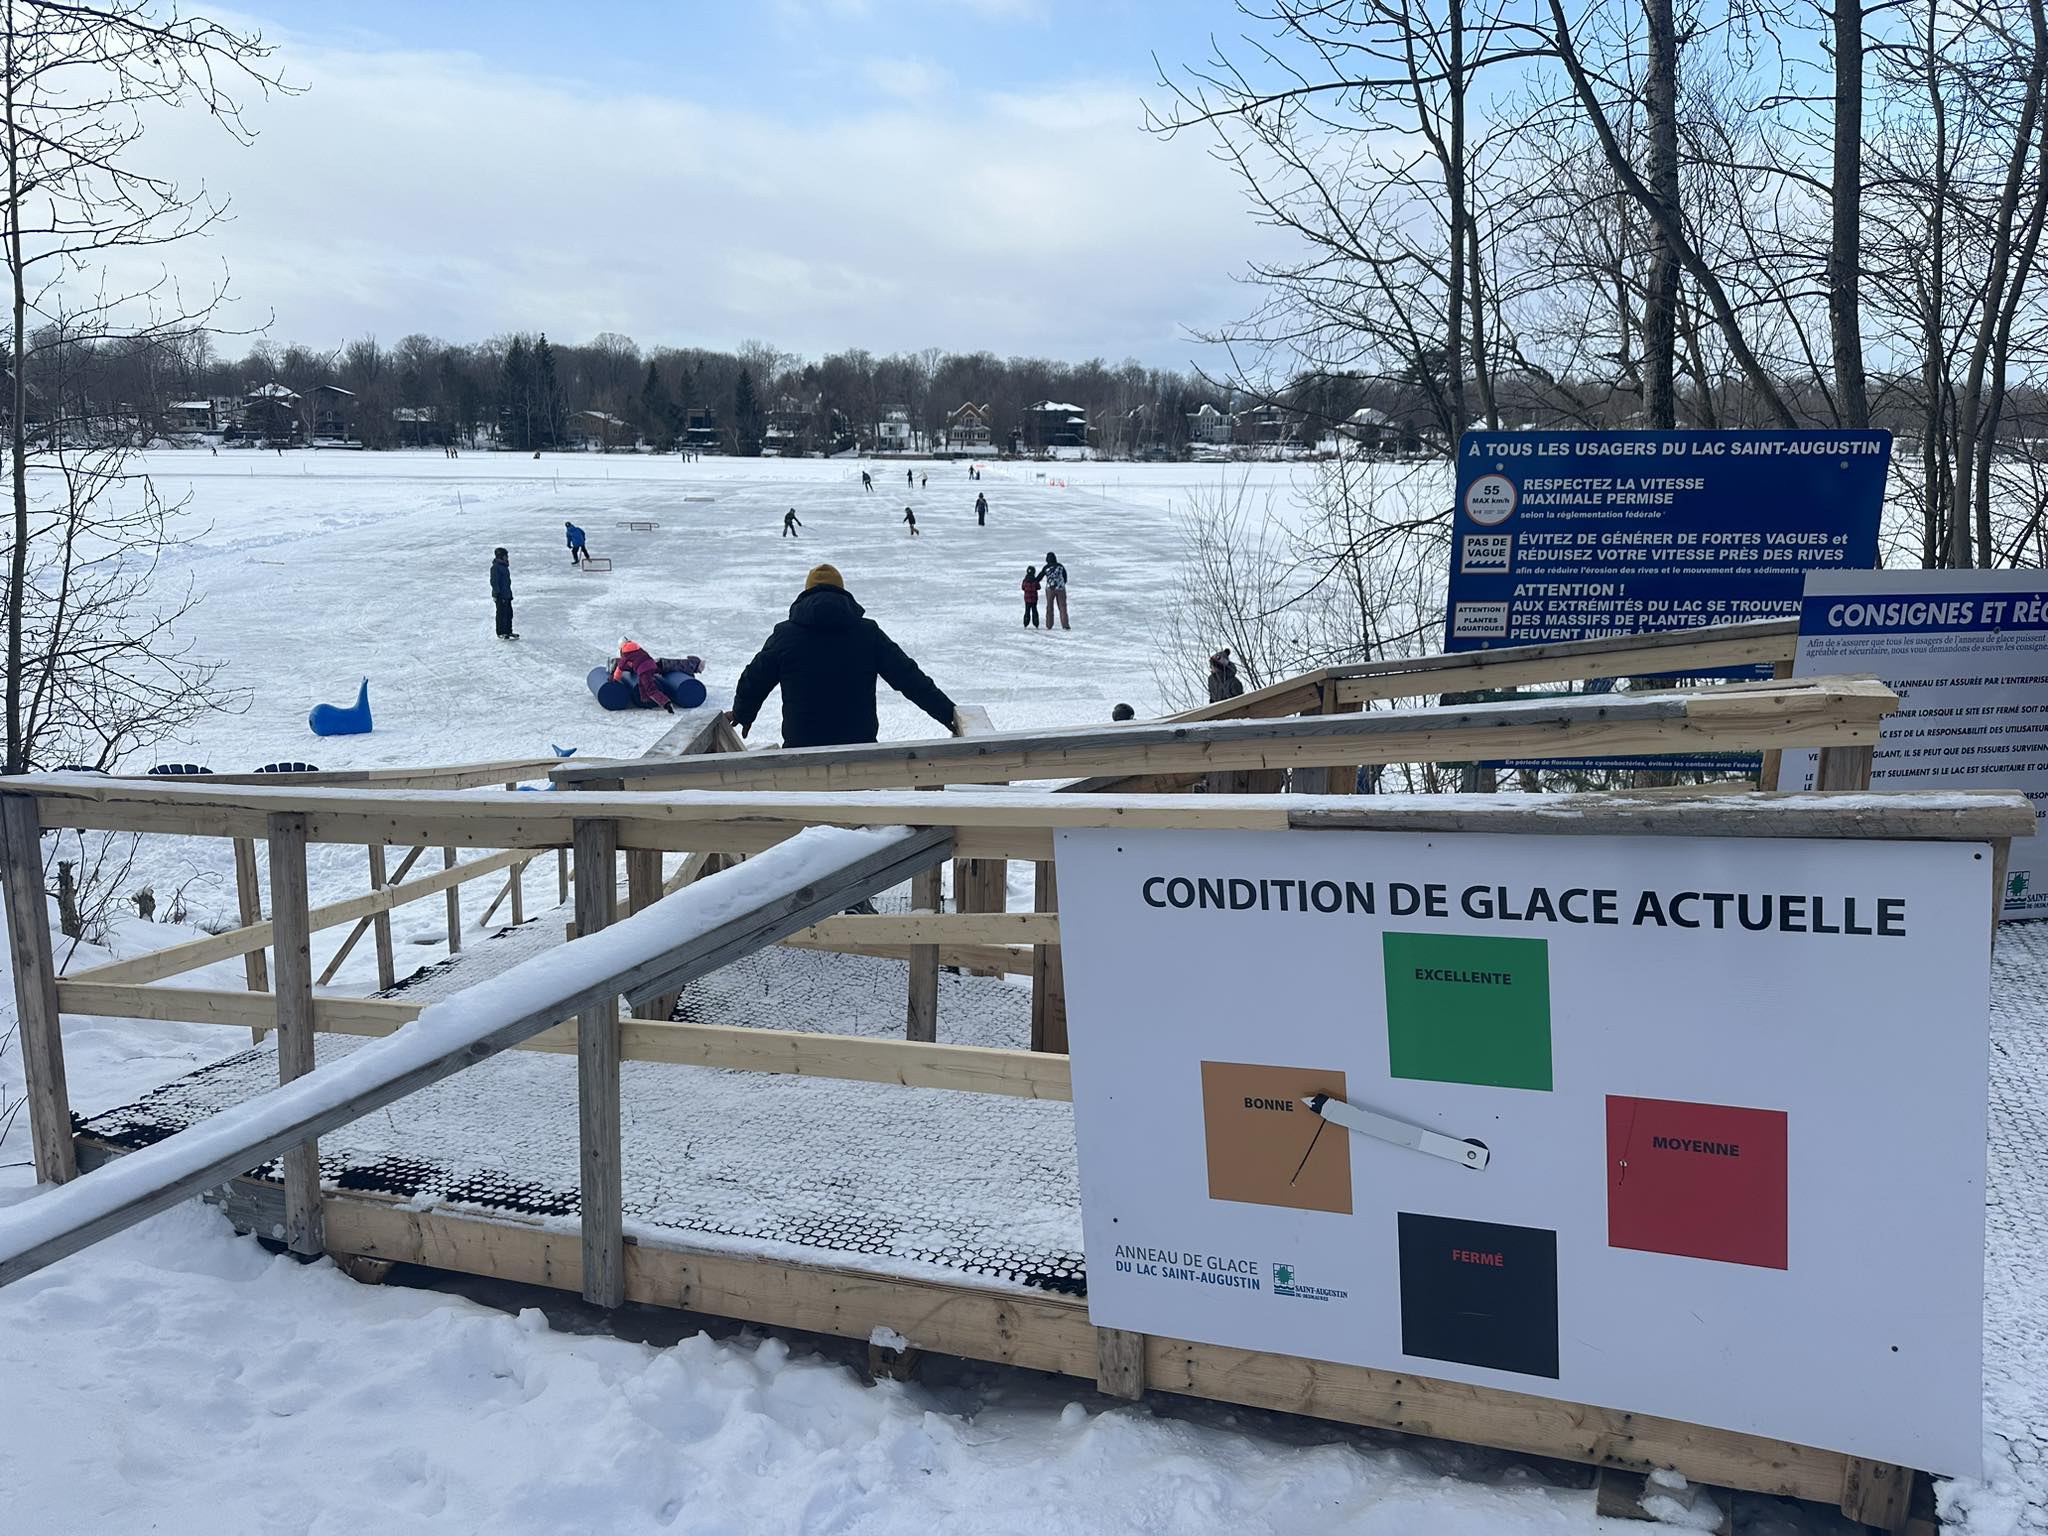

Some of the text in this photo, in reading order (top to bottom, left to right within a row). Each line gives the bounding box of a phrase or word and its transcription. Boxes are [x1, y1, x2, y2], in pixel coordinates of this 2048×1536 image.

[1469, 441, 1881, 457] À TOUS LES USAGERS DU LAC SAINT-AUGUSTIN
[1483, 485, 1500, 495] 55
[1523, 478, 1705, 490] RESPECTEZ LA VITESSE
[1522, 493, 1674, 505] MAXIMALE PERMISE
[1520, 511, 1624, 521] selon la réglementation
[1467, 538, 1507, 547] PAS DE
[1518, 531, 1849, 545] ÉVITEZ DE GÉNÉRER DE FORTES VAGUES et
[1467, 548, 1506, 558] VAGUE
[1517, 546, 1844, 561] RÉDUISEZ VOTRE VITESSE PRÈS DES RIVES
[1515, 566, 1532, 574] afin
[1534, 566, 1546, 574] de
[1547, 566, 1579, 574] réduire
[1620, 566, 1636, 574] des
[1637, 566, 1659, 574] rives
[1753, 566, 1800, 574] sédiments
[1514, 583, 1625, 596] ATTENTION !
[1512, 597, 1801, 612] AUX EXTRÉMITÉS DU LAC SE TROUVEN
[1511, 614, 1541, 626] DES
[1545, 614, 1610, 626] MASSIFS
[1614, 614, 1635, 626] DE
[1638, 614, 1707, 626] PLANTES
[1828, 602, 1975, 628] CONSIGNES
[1980, 601, 2008, 624] ET
[1456, 625, 1505, 633] AQUATIQUES
[1510, 628, 1580, 640] PEUVENT
[1808, 638, 1824, 648] Afin
[1825, 638, 1835, 647] de
[1836, 637, 1870, 647] s'assurer
[1870, 639, 1885, 648] que
[1886, 637, 1902, 646] tous
[1904, 636, 1914, 645] les
[1915, 636, 1943, 647] usagers
[1944, 635, 1954, 644] de
[1986, 634, 1995, 643] de
[1995, 634, 2015, 644] glace
[2015, 633, 2046, 644] puissent
[1806, 647, 1839, 658] agréable
[1839, 647, 1848, 656] et
[1890, 647, 1909, 655] nous
[1910, 646, 1927, 654] vous
[1928, 644, 1970, 653] demandons
[1971, 643, 1980, 652] de
[1982, 643, 2004, 652] suivre
[2004, 642, 2015, 651] les
[1893, 679, 1934, 688] L'ANNEAU
[1936, 679, 1949, 687] EST
[1949, 676, 1983, 687] ASSURÉE
[1984, 677, 2000, 685] PAR
[1918, 708, 1954, 718] LORSQUE
[1955, 708, 1964, 716] LE
[1965, 707, 1980, 716] SITE
[1981, 706, 1995, 715] EST
[1995, 704, 2020, 714] FERMÉ
[2021, 705, 2038, 713] SOIT
[1889, 730, 1903, 738] EST
[1904, 729, 1914, 738] DE
[1915, 729, 1925, 737] LA
[1926, 724, 1988, 737] RESPONSABILITÉ
[1989, 726, 2004, 734] DES
[1904, 749, 1911, 758] IL
[1912, 748, 1922, 757] SE
[1923, 748, 1942, 756] PEUT
[1943, 747, 1960, 755] QUE
[1961, 746, 1976, 755] DES
[1976, 745, 2010, 754] FISSURES
[1805, 773, 1814, 781] LE
[1887, 768, 1931, 778] SEULEMENT
[1932, 767, 1940, 776] SI
[1941, 767, 1950, 775] LE
[1950, 766, 1965, 775] LAC
[1966, 765, 1980, 774] EST
[1981, 763, 2026, 773] SÉCURITAIRE
[2027, 763, 2036, 771] ET
[1803, 783, 1813, 791] LE
[1142, 876, 1907, 937] CONDITION DE GLACE ACTUELLE
[1415, 968, 1513, 986] EXCELLENTE
[1244, 1097, 1294, 1112] BONNE
[1652, 1136, 1740, 1157] MOYENNE
[1115, 1244, 1259, 1275] ANNEAU DE GLACE
[1452, 1248, 1504, 1267] FERMÉ
[1115, 1260, 1261, 1291] DU LAC SAINT-AUGUSTIN
